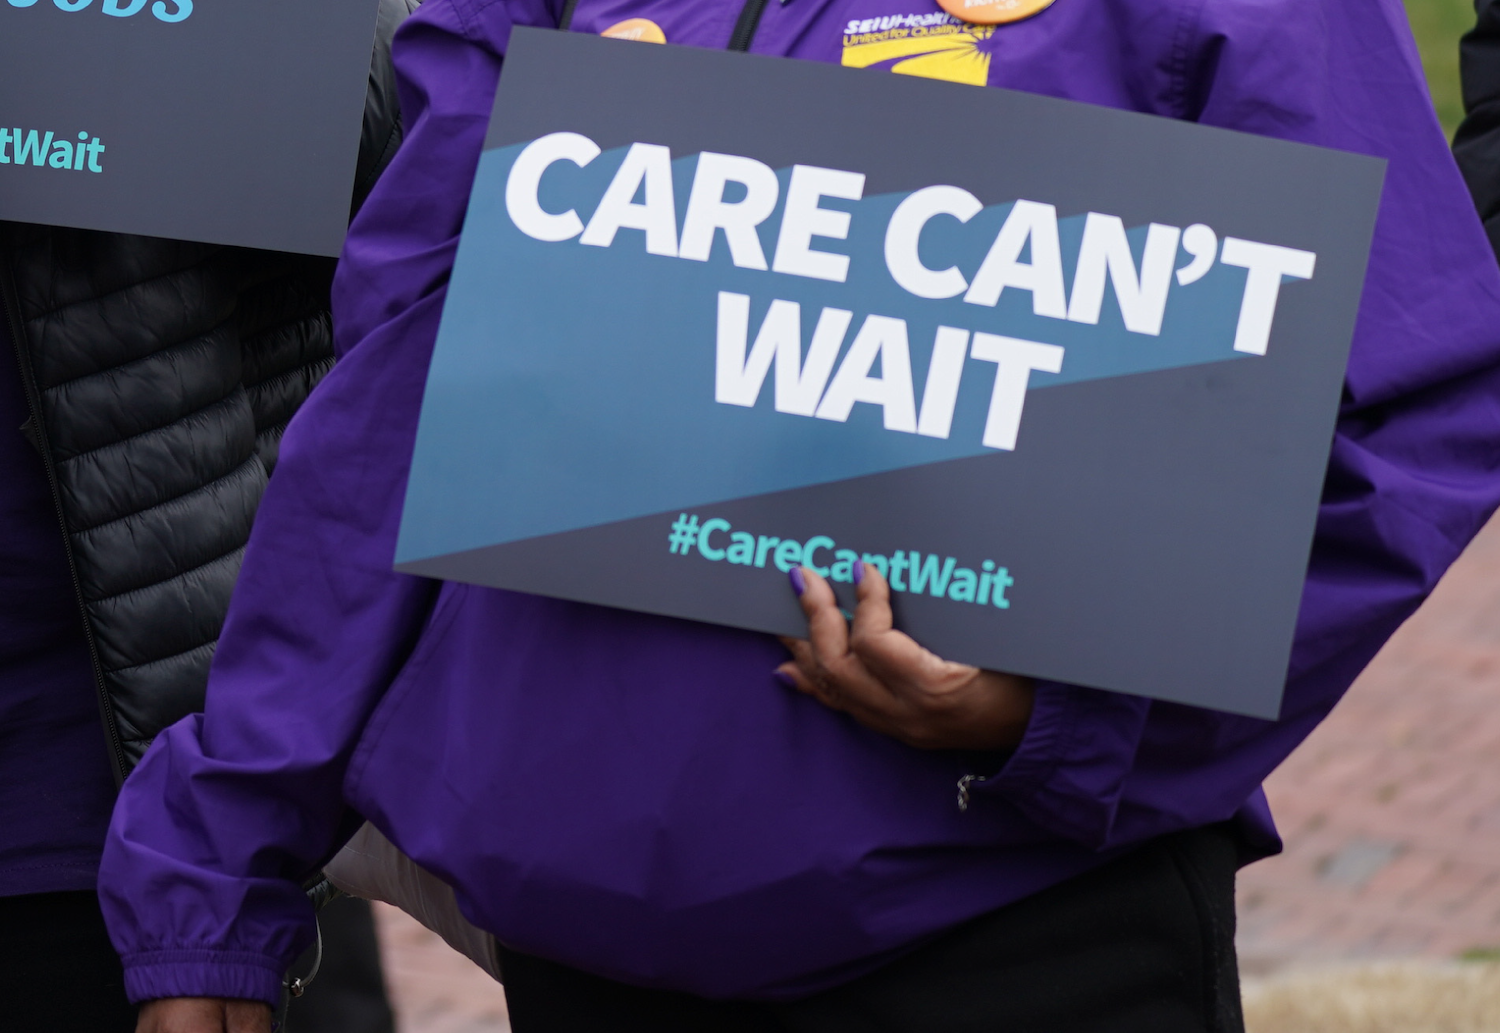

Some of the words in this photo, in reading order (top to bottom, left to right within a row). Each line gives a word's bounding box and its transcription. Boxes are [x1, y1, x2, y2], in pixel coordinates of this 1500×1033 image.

[890, 27, 910, 39] for
[505, 132, 866, 283] CARE
[884, 185, 1317, 356] CAN'T
[715, 291, 1065, 451] WAIT
